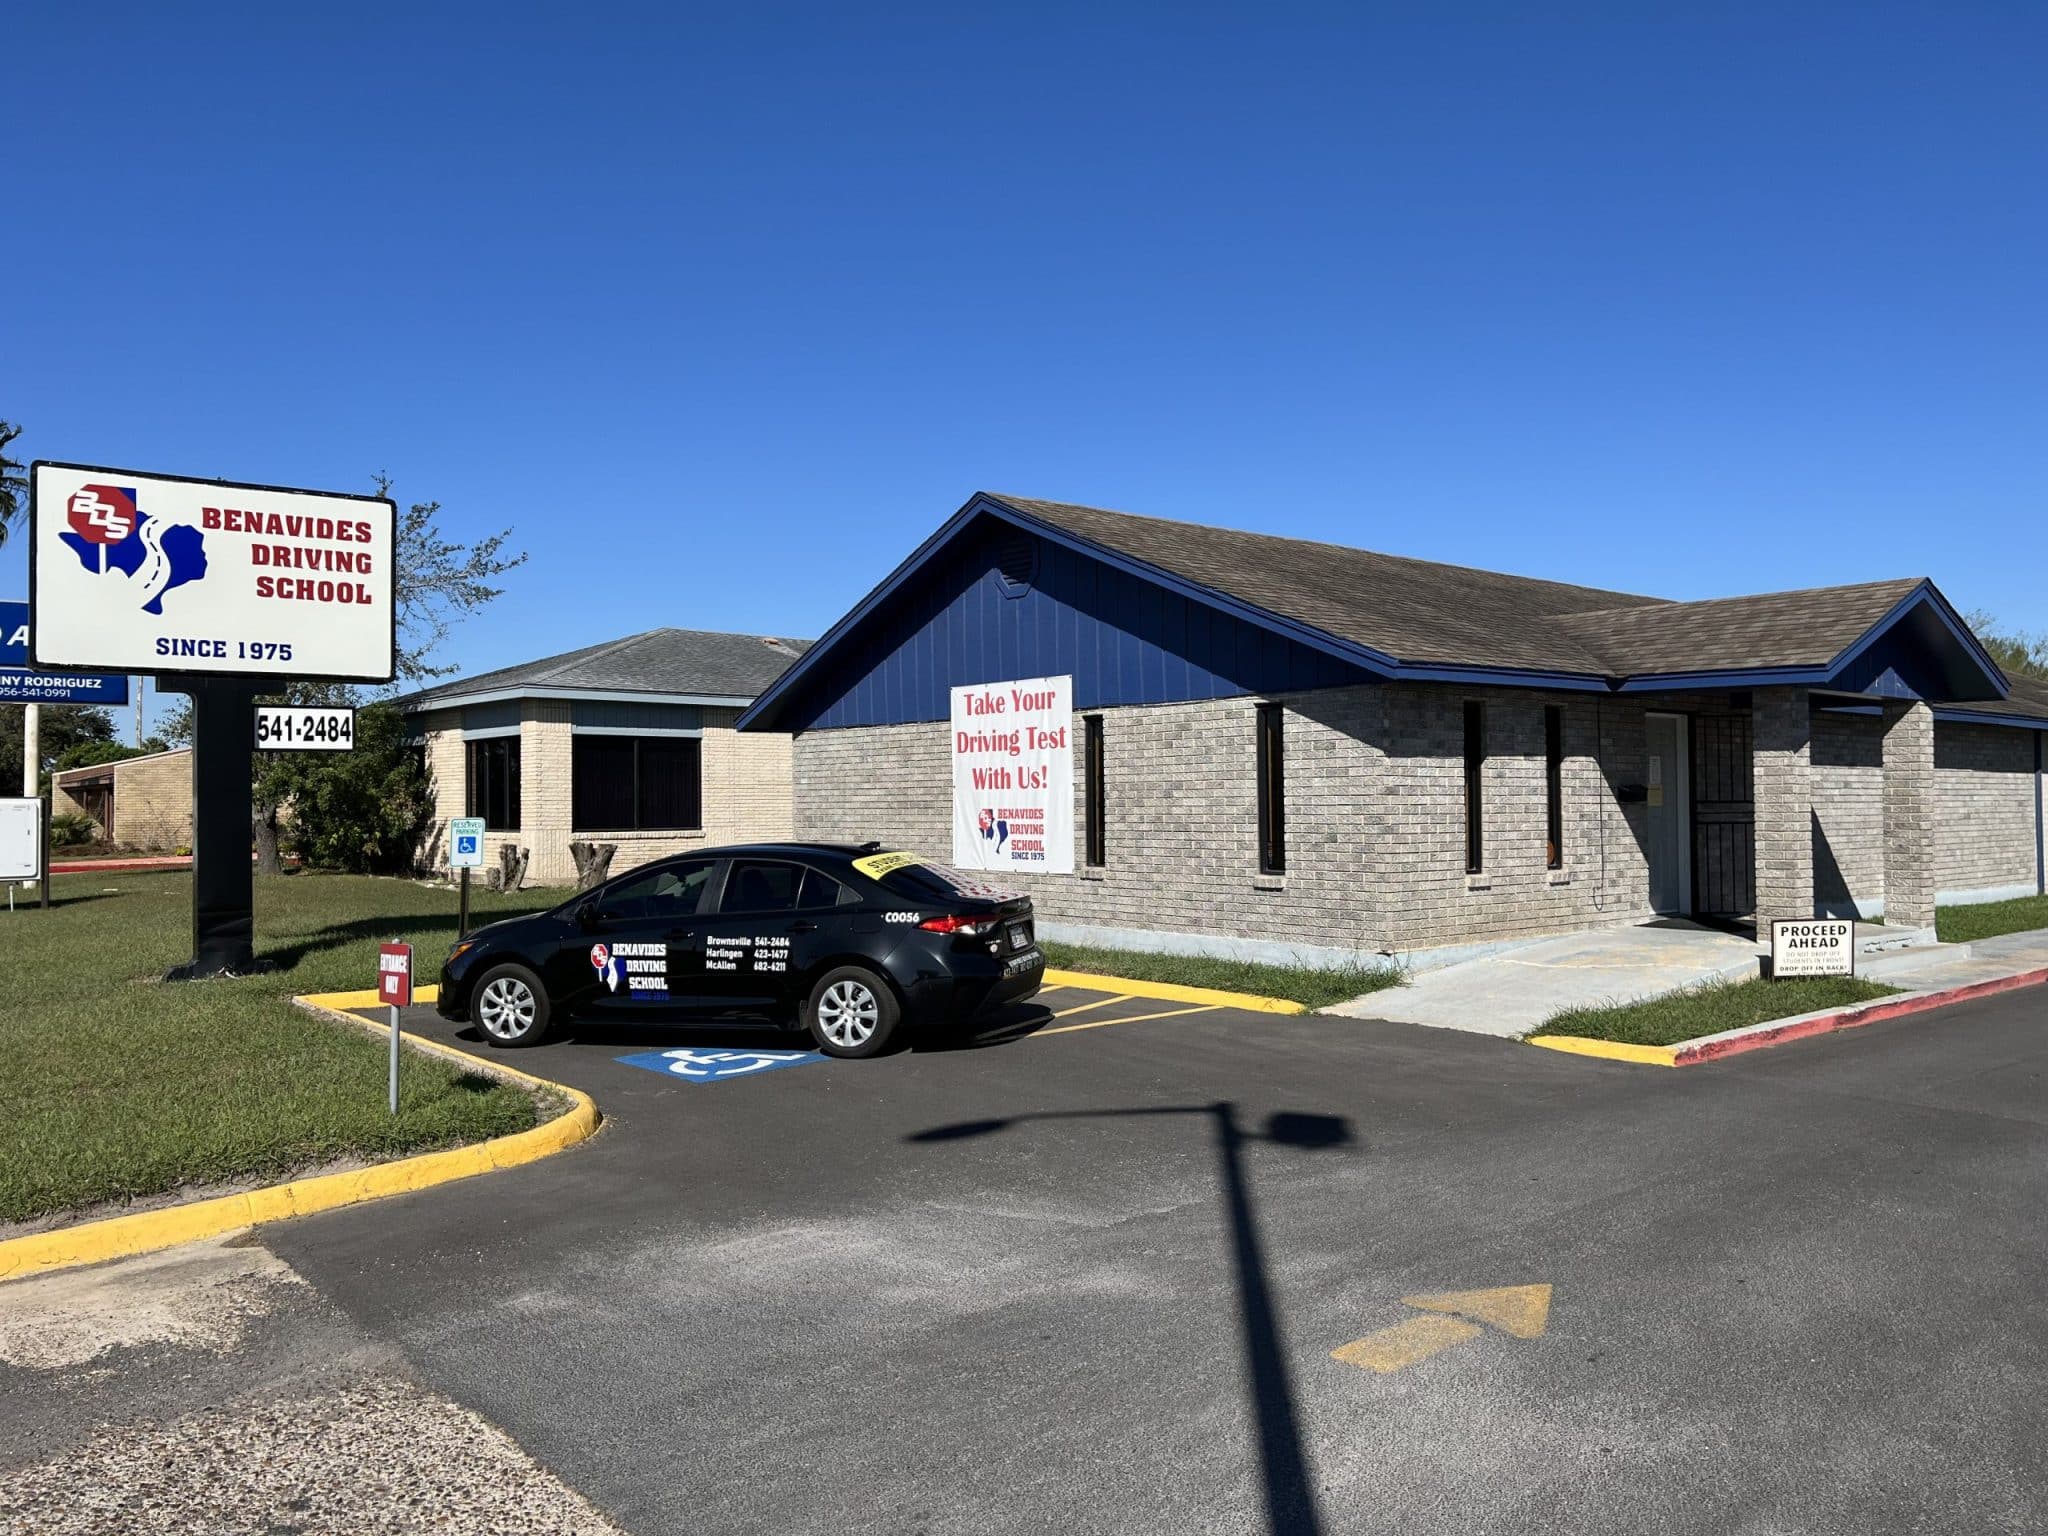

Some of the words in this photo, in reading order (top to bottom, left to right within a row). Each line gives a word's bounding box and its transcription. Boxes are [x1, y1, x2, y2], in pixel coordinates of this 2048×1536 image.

[202, 507, 372, 543] BENAVIDES
[252, 544, 372, 574] DRIVING
[257, 576, 372, 604] SCHOOL
[156, 637, 227, 658] SINCE
[238, 641, 292, 661] 1975
[0, 676, 21, 686] NY
[24, 677, 102, 688] RODRIGUEZ
[964, 692, 1005, 715] Take
[1012, 688, 1055, 712] Your
[257, 714, 352, 741] 541-2484
[957, 729, 1020, 756] Driving
[1026, 726, 1066, 750] Test
[972, 766, 1011, 790] With
[1018, 765, 1047, 789] Us!
[997, 808, 1044, 819] BENAVIDES
[1009, 823, 1044, 835] DRIVING
[1011, 839, 1044, 851] SCHOOL
[1011, 851, 1029, 860] SINCE
[1781, 925, 1847, 936] PROCEED
[707, 935, 751, 946] Brownsville
[1788, 937, 1839, 948] AHEAD
[612, 943, 667, 956] BENAVIDES
[706, 948, 743, 960] Harlingen
[626, 960, 667, 973] DRIVING
[706, 960, 737, 970] McAllen
[629, 976, 668, 990] SCHOOL
